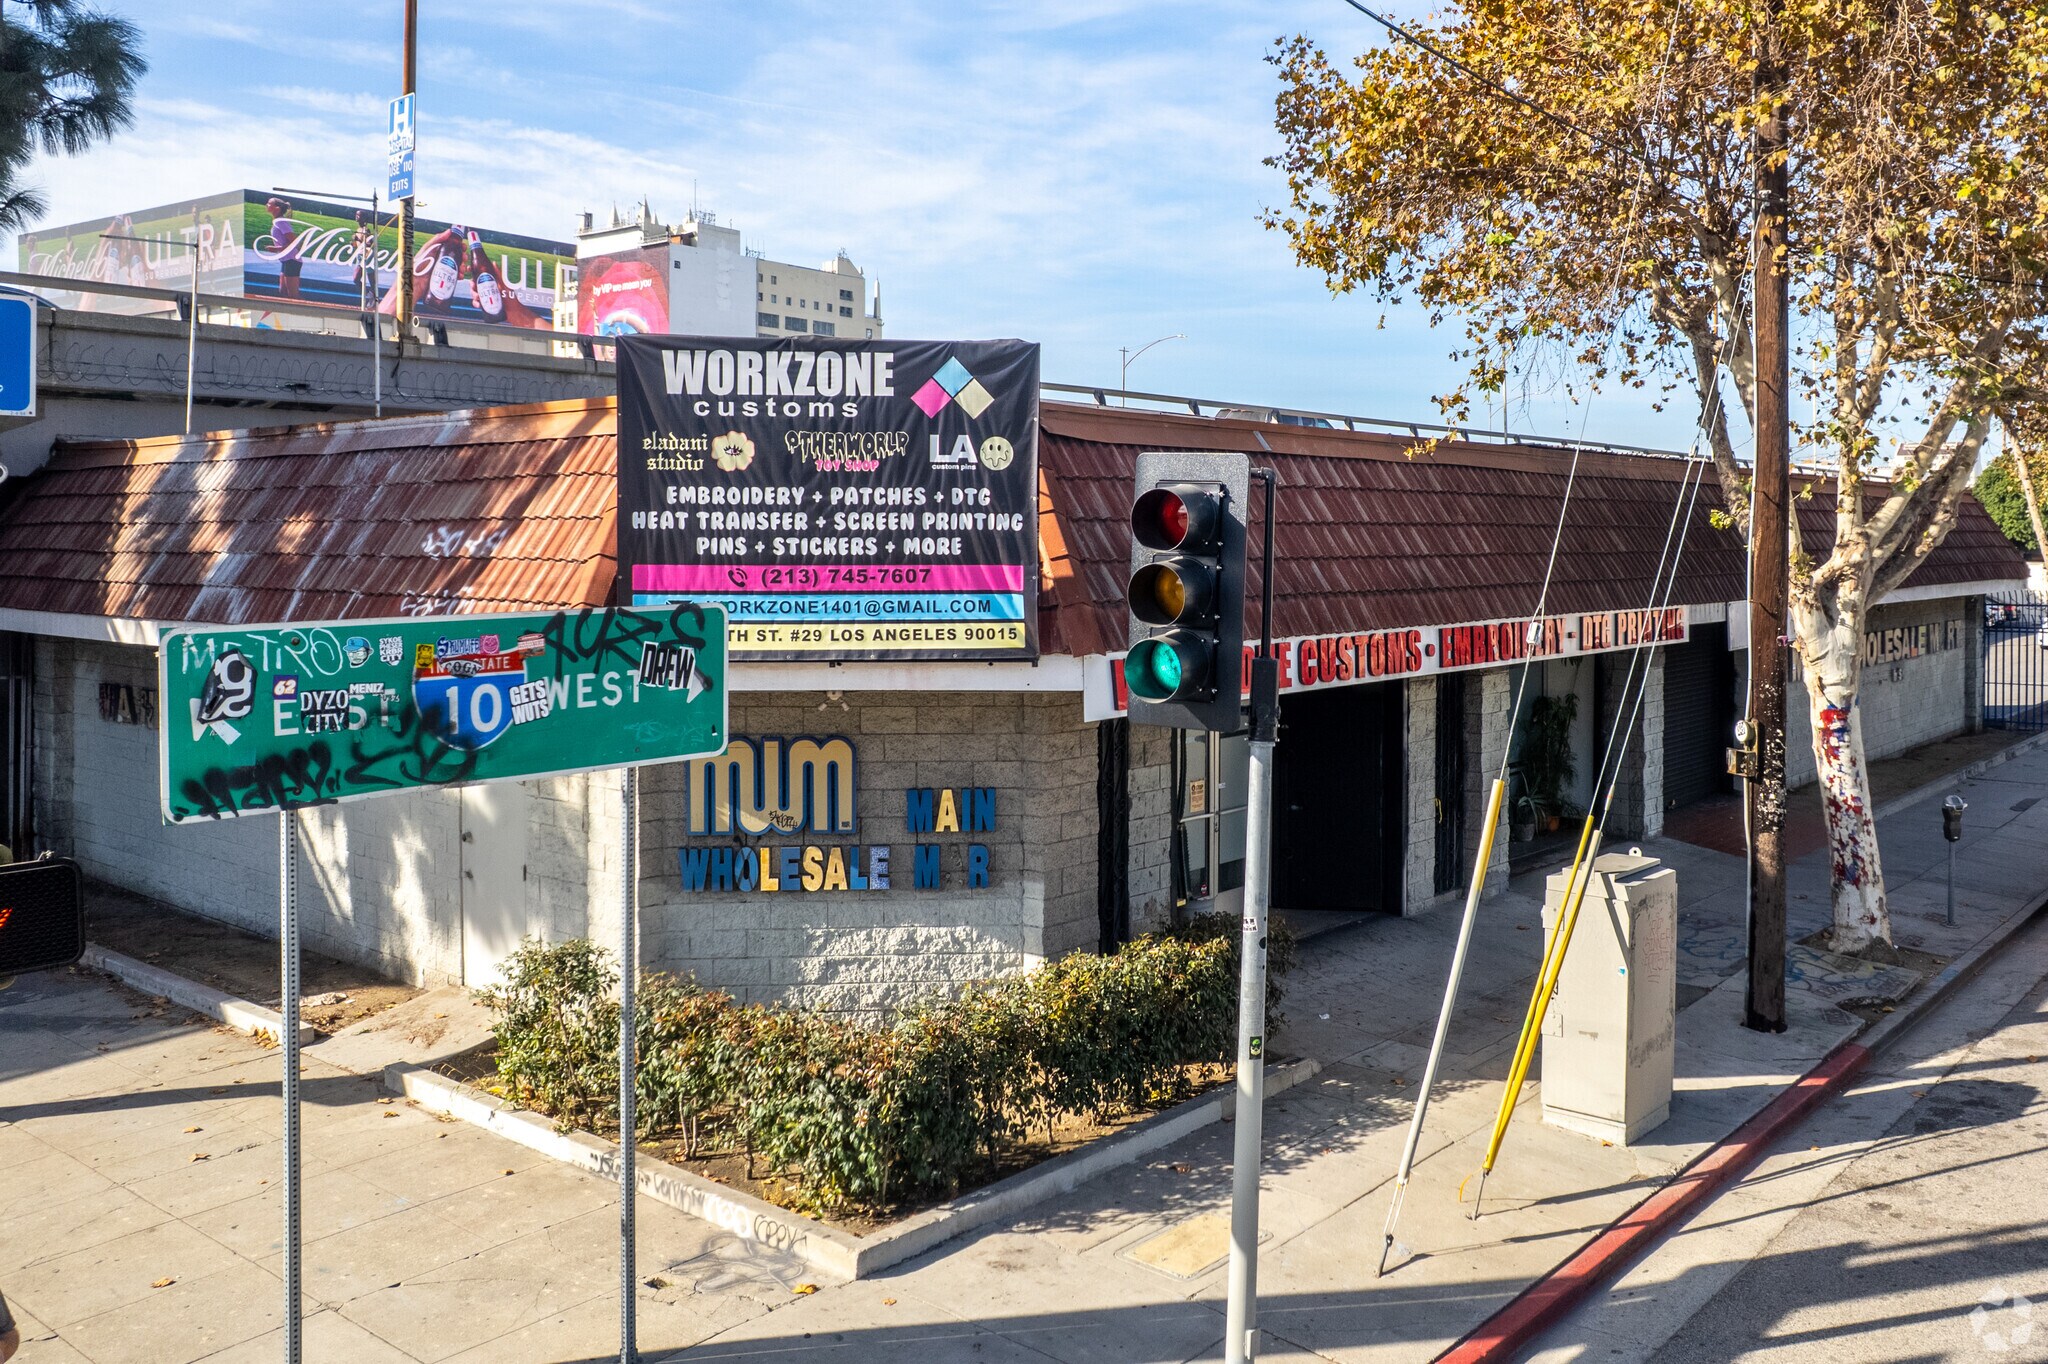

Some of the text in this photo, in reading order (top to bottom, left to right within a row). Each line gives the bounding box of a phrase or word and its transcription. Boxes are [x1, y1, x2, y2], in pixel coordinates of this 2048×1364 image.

[393, 98, 410, 138] H
[403, 160, 413, 172] 110
[391, 178, 409, 193] EXITS
[145, 219, 236, 271] ULTRA
[253, 217, 443, 277] Michelb
[501, 288, 555, 304] SUPERIO
[593, 285, 601, 297] by
[601, 283, 613, 294] VIP
[622, 281, 640, 291] mean
[640, 279, 653, 290] you
[661, 349, 895, 397] WORKZONE
[693, 399, 859, 418] customs
[642, 431, 708, 451] eladani
[929, 434, 978, 463] LA
[646, 452, 704, 471] studio
[815, 458, 880, 472] TOY SHOP
[960, 463, 976, 471] pins
[666, 486, 804, 505] EMBROIDERY
[830, 486, 926, 505] PATCHES
[953, 487, 991, 505] DTG
[632, 511, 688, 530] HEAT
[696, 511, 808, 530] TRANSFER
[833, 512, 914, 531] SCREEN
[921, 512, 1023, 531] PRINTING
[696, 537, 748, 556] PINS
[772, 536, 878, 556] STICKERS
[903, 537, 962, 556] MORE
[760, 569, 932, 587] (213) 745-7607
[707, 600, 992, 617] ORKZONE1401@GMAIL.COM
[757, 630, 782, 642] ST.
[790, 629, 822, 642] #29
[830, 629, 864, 642] LOS
[872, 628, 957, 642] ANGELES
[964, 627, 1018, 641] 90015
[1300, 629, 1422, 686] CUSTOMS
[1580, 614, 1612, 650] DTG
[1616, 607, 1685, 646] PRINTING
[1859, 626, 1927, 668] HOLESALE
[349, 683, 385, 694] MENIZ
[509, 680, 546, 706] GETS
[544, 670, 641, 711] WEST
[300, 690, 349, 711] DYZO
[446, 683, 502, 735] 10
[273, 688, 397, 736] EST
[512, 699, 549, 725] WUTS
[907, 787, 996, 833] MAIN
[679, 845, 891, 892] WHOLESALE
